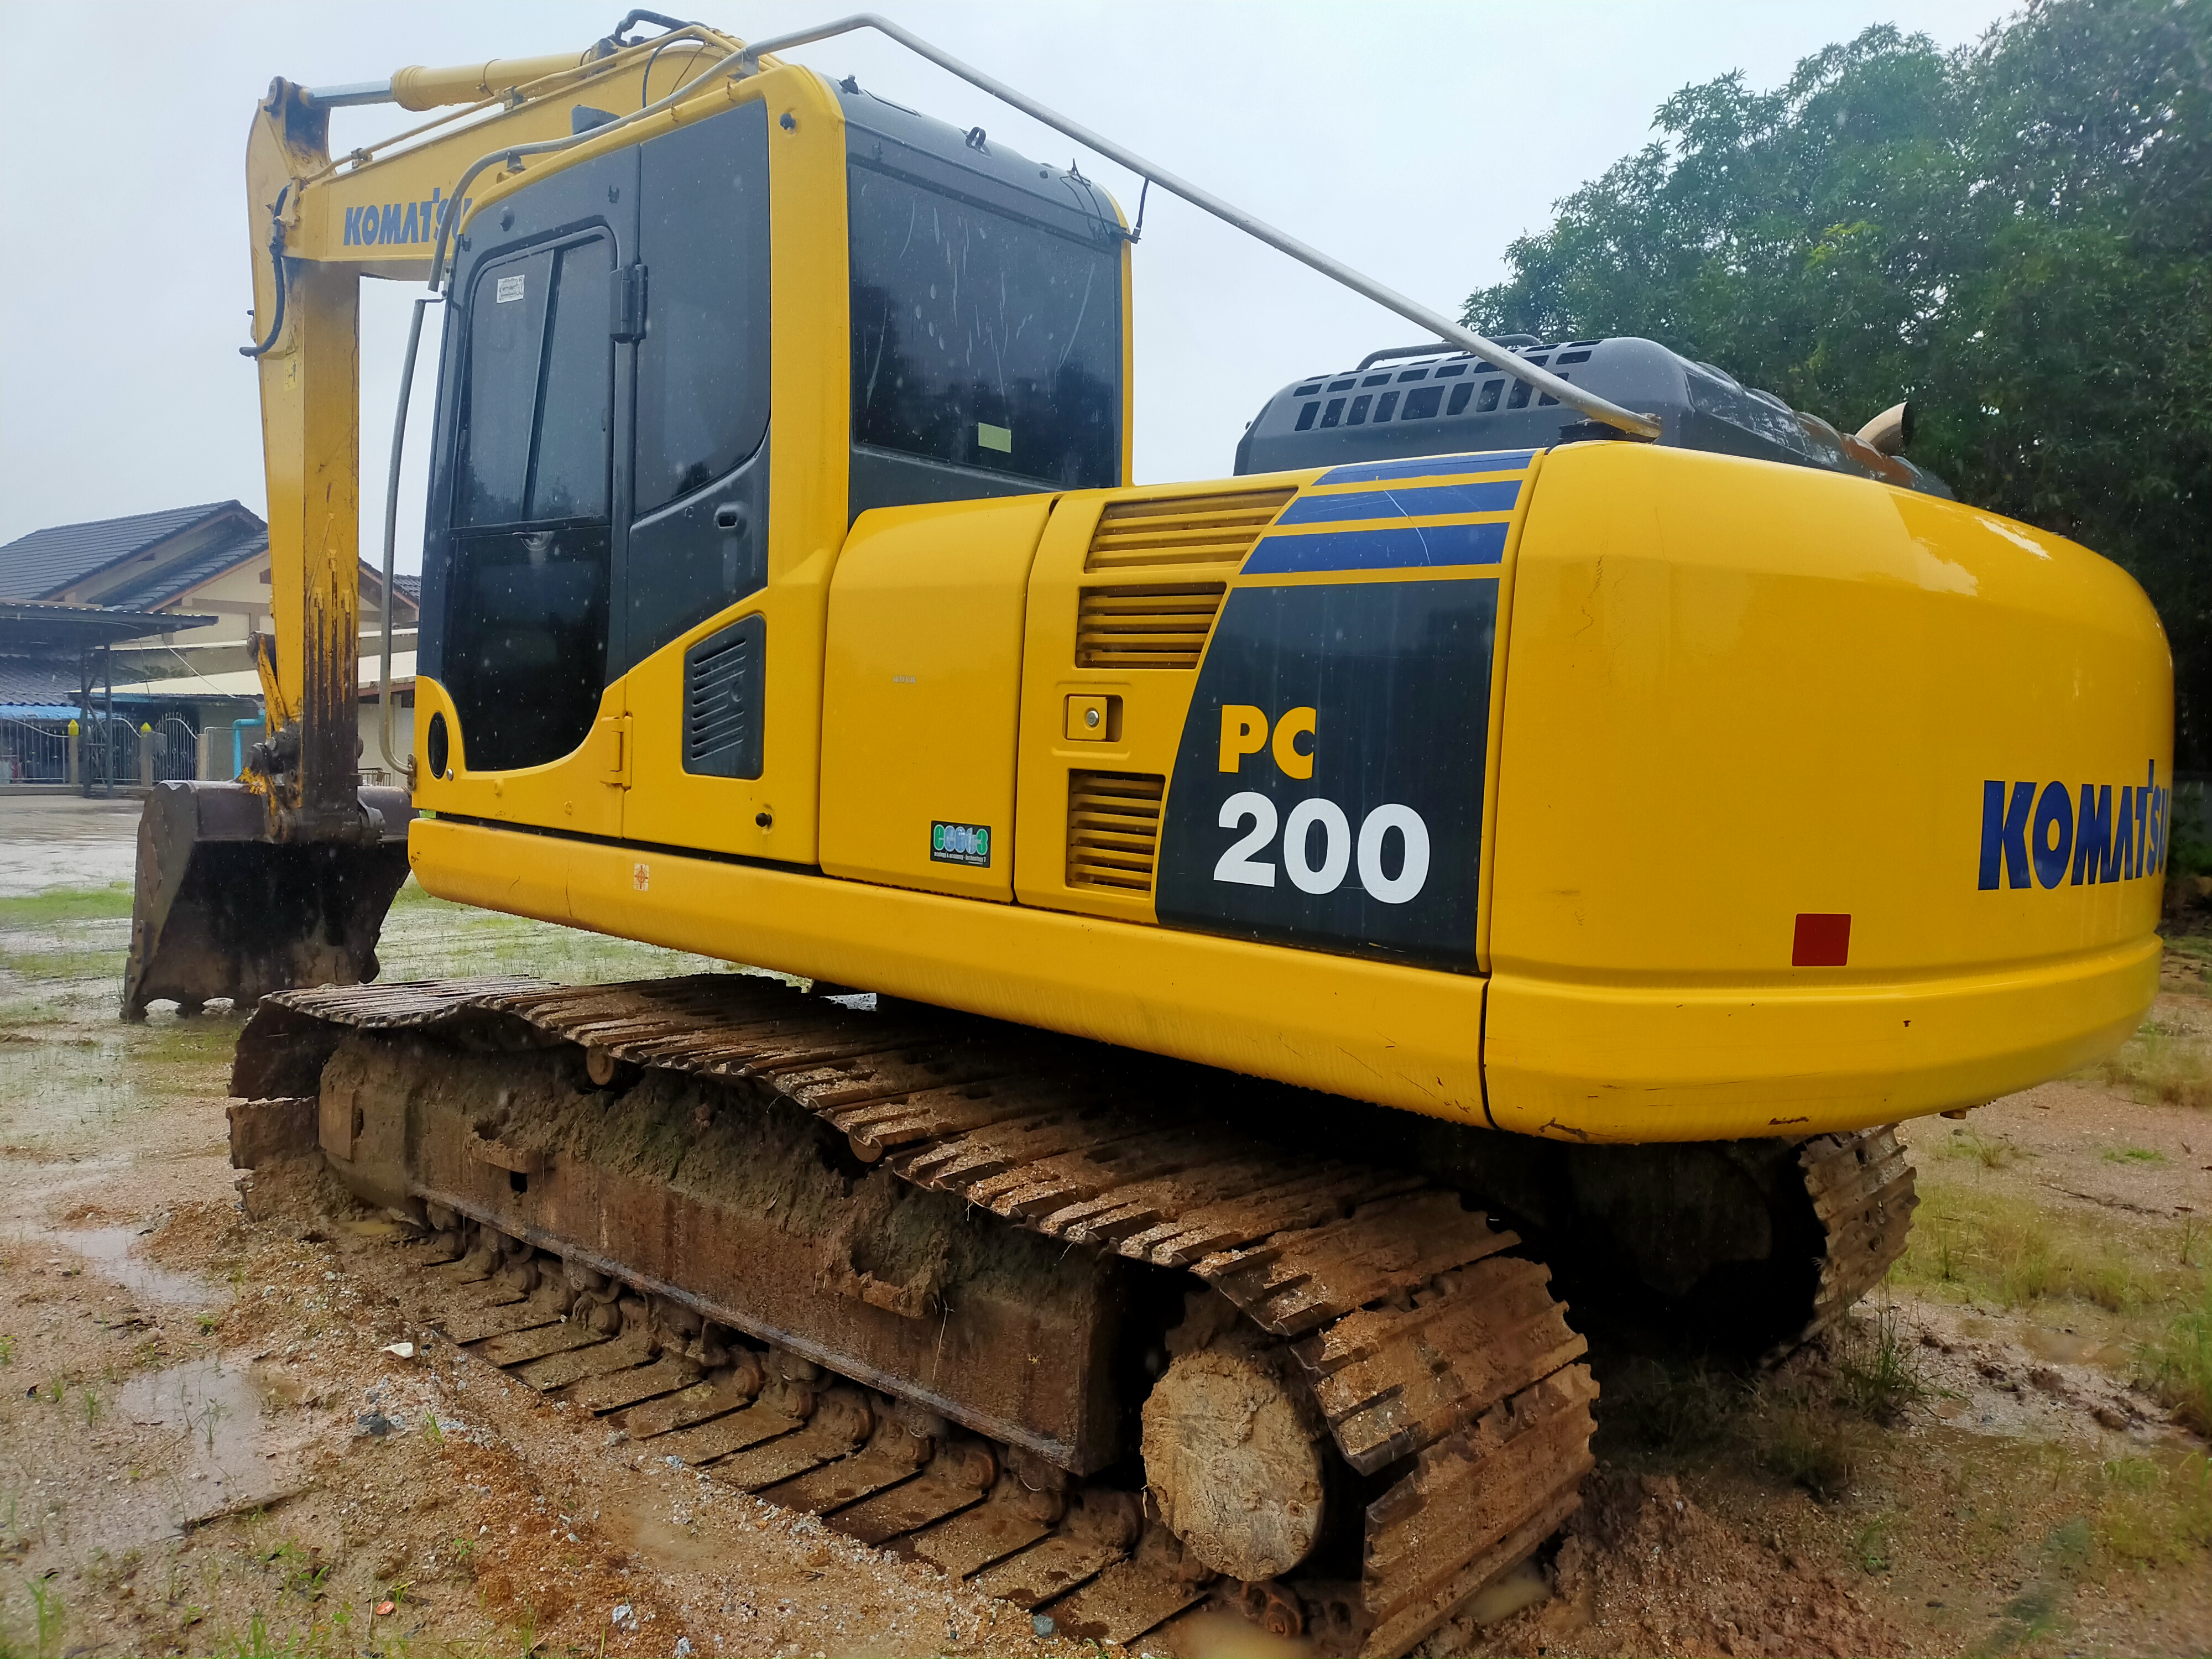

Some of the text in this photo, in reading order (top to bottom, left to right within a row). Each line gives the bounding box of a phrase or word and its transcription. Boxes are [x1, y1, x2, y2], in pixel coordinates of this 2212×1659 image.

[1218, 704, 1317, 779] PC
[1213, 791, 1430, 904] 200
[1978, 759, 2169, 891] KOMATSU
